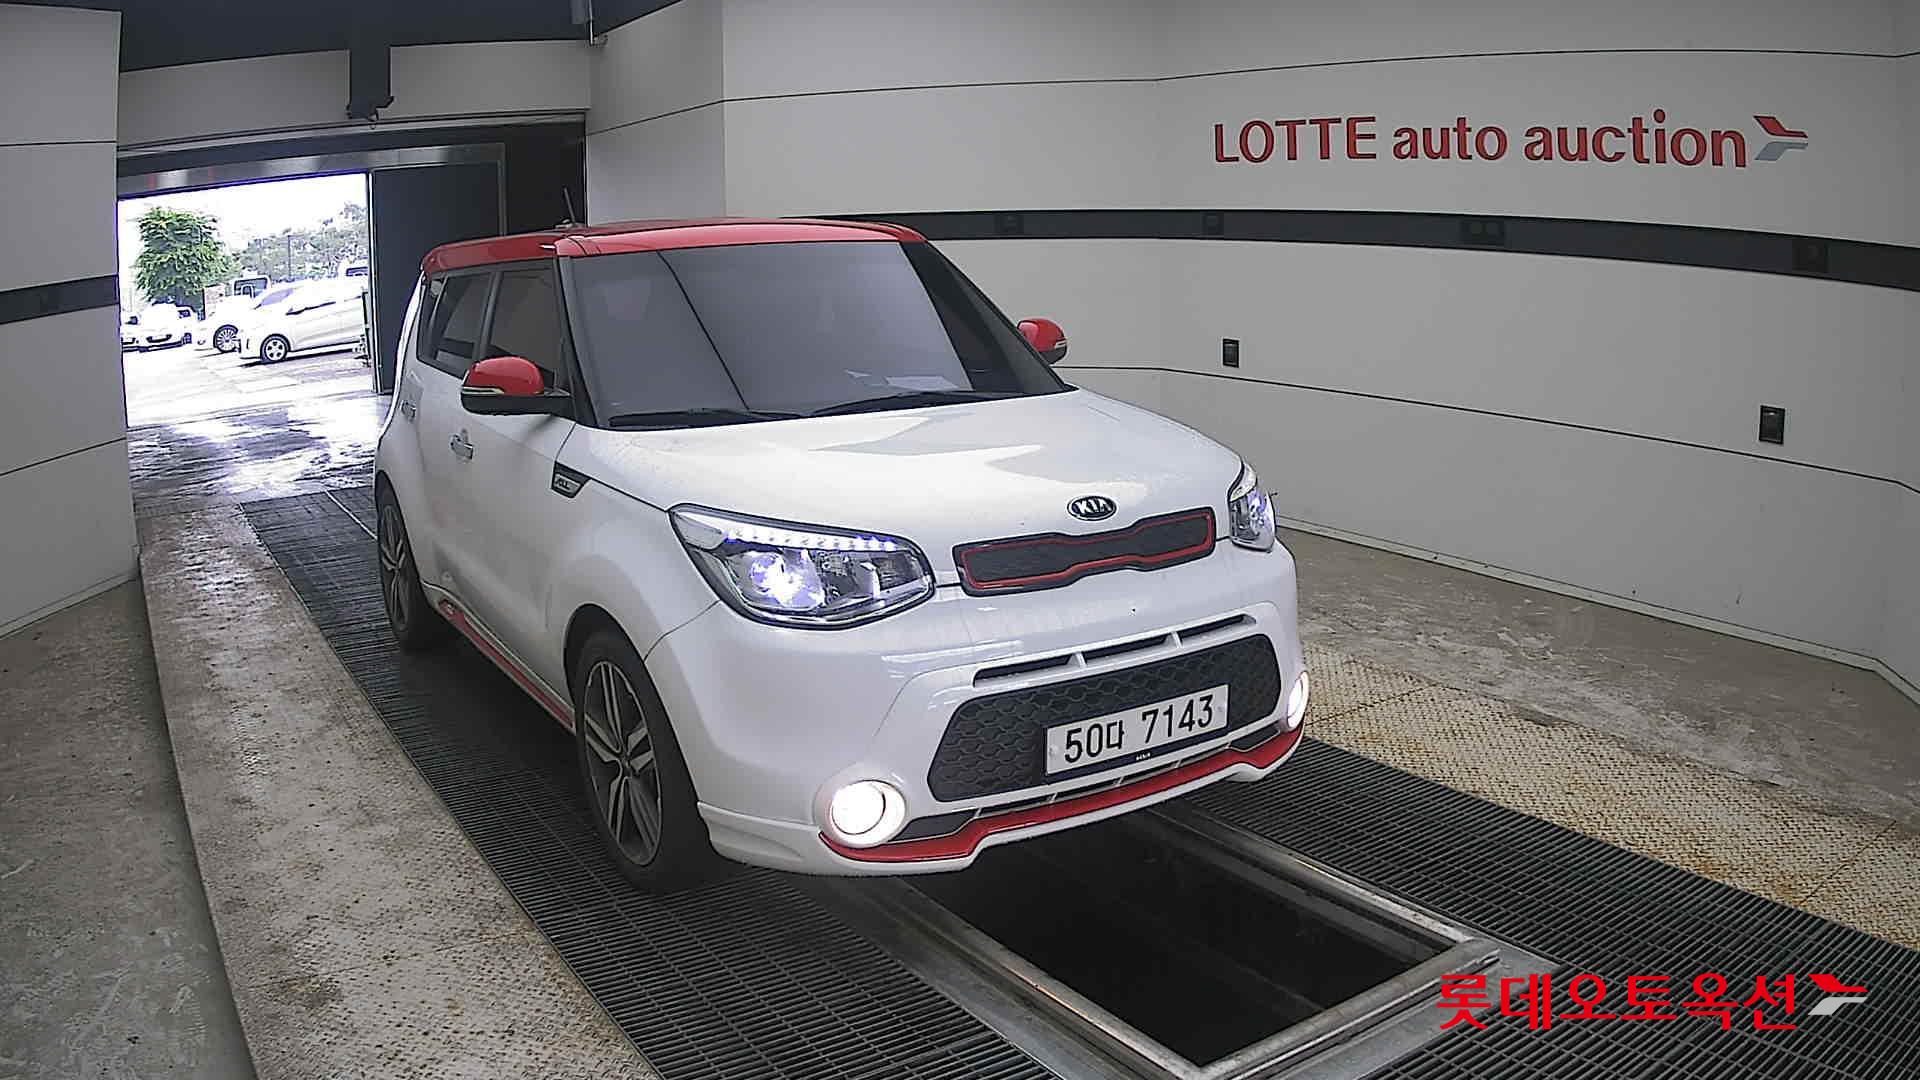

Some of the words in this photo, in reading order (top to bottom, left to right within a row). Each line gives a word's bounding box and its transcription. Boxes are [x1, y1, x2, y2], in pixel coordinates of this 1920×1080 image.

[1213, 116, 1377, 163] LOTTE
[1392, 116, 1509, 161] auto
[1523, 109, 1747, 168] auction
[1072, 498, 1112, 514] KIA
[1141, 694, 1214, 744] 7143
